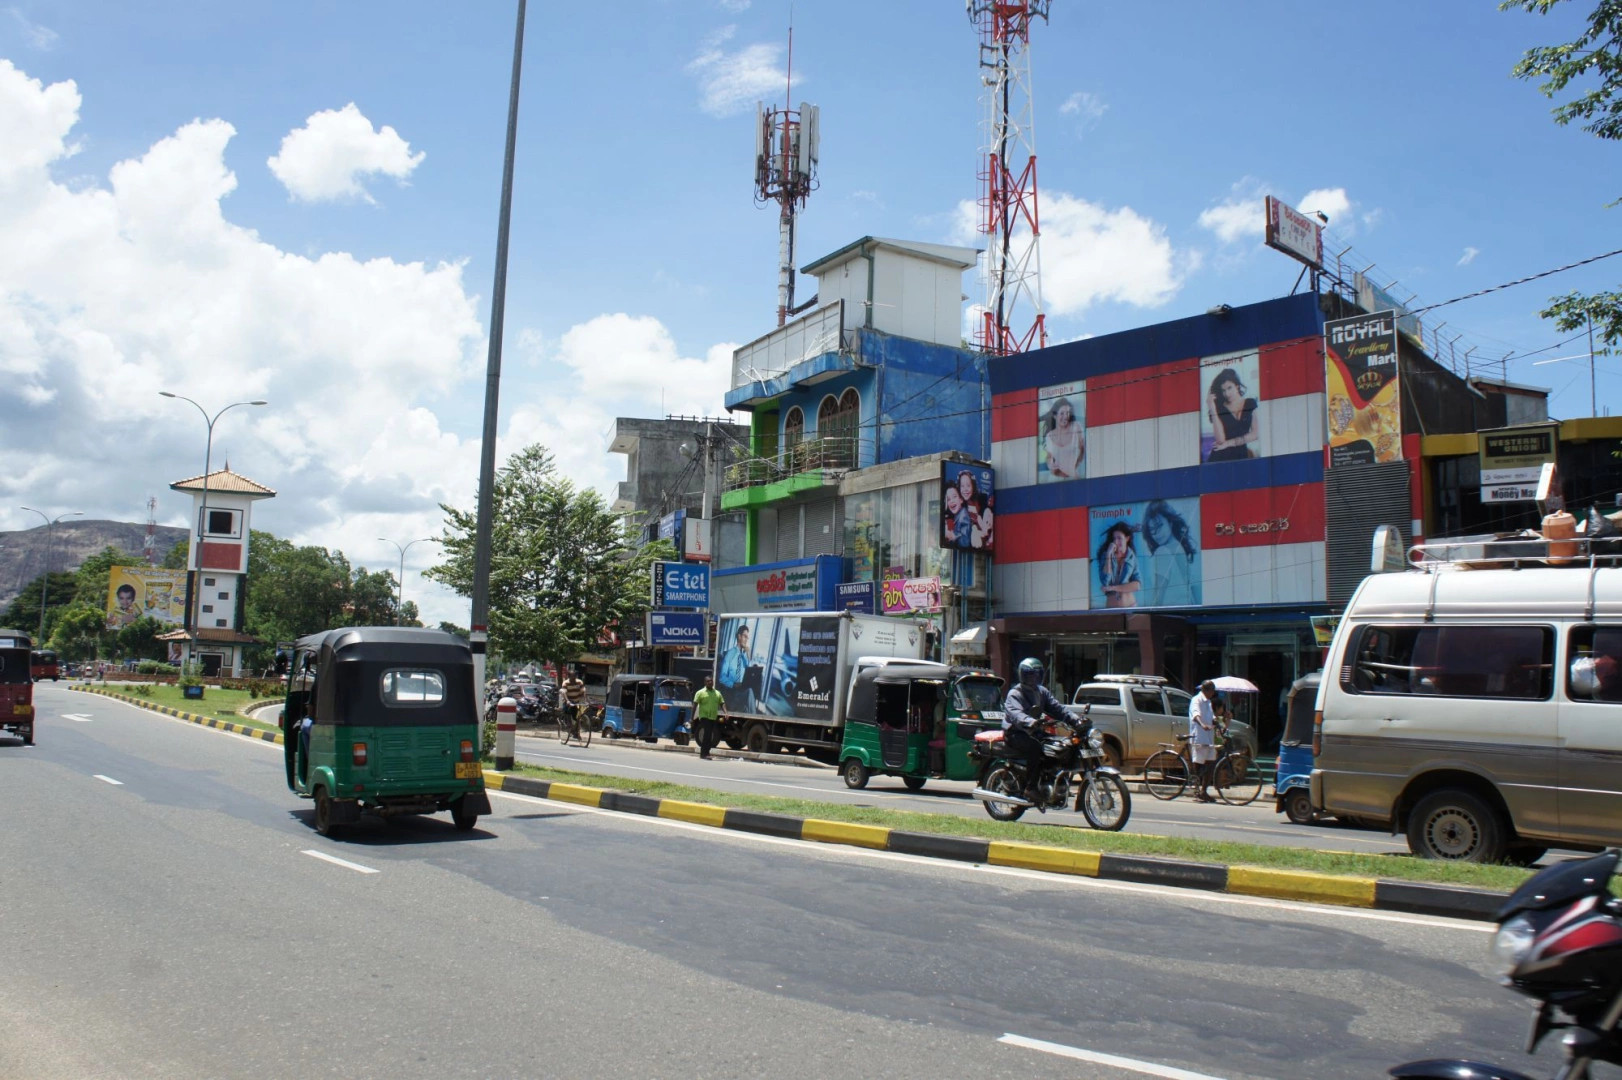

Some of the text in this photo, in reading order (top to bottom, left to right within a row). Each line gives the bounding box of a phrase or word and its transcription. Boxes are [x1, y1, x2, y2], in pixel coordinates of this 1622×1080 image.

[1332, 319, 1393, 344] ROYAL
[1203, 357, 1237, 369] Triumph
[1367, 352, 1396, 367] Mart
[1040, 386, 1068, 397] Triumph
[1489, 438, 1537, 447] WESTERN
[1504, 445, 1537, 453] UNION
[1491, 489, 1519, 500] Money
[1092, 509, 1124, 520] Triumph
[839, 583, 870, 595] SAMSUNG
[665, 592, 706, 602] SMARTPHONE
[662, 627, 700, 636] NOKIA
[798, 691, 830, 701] Emerald
